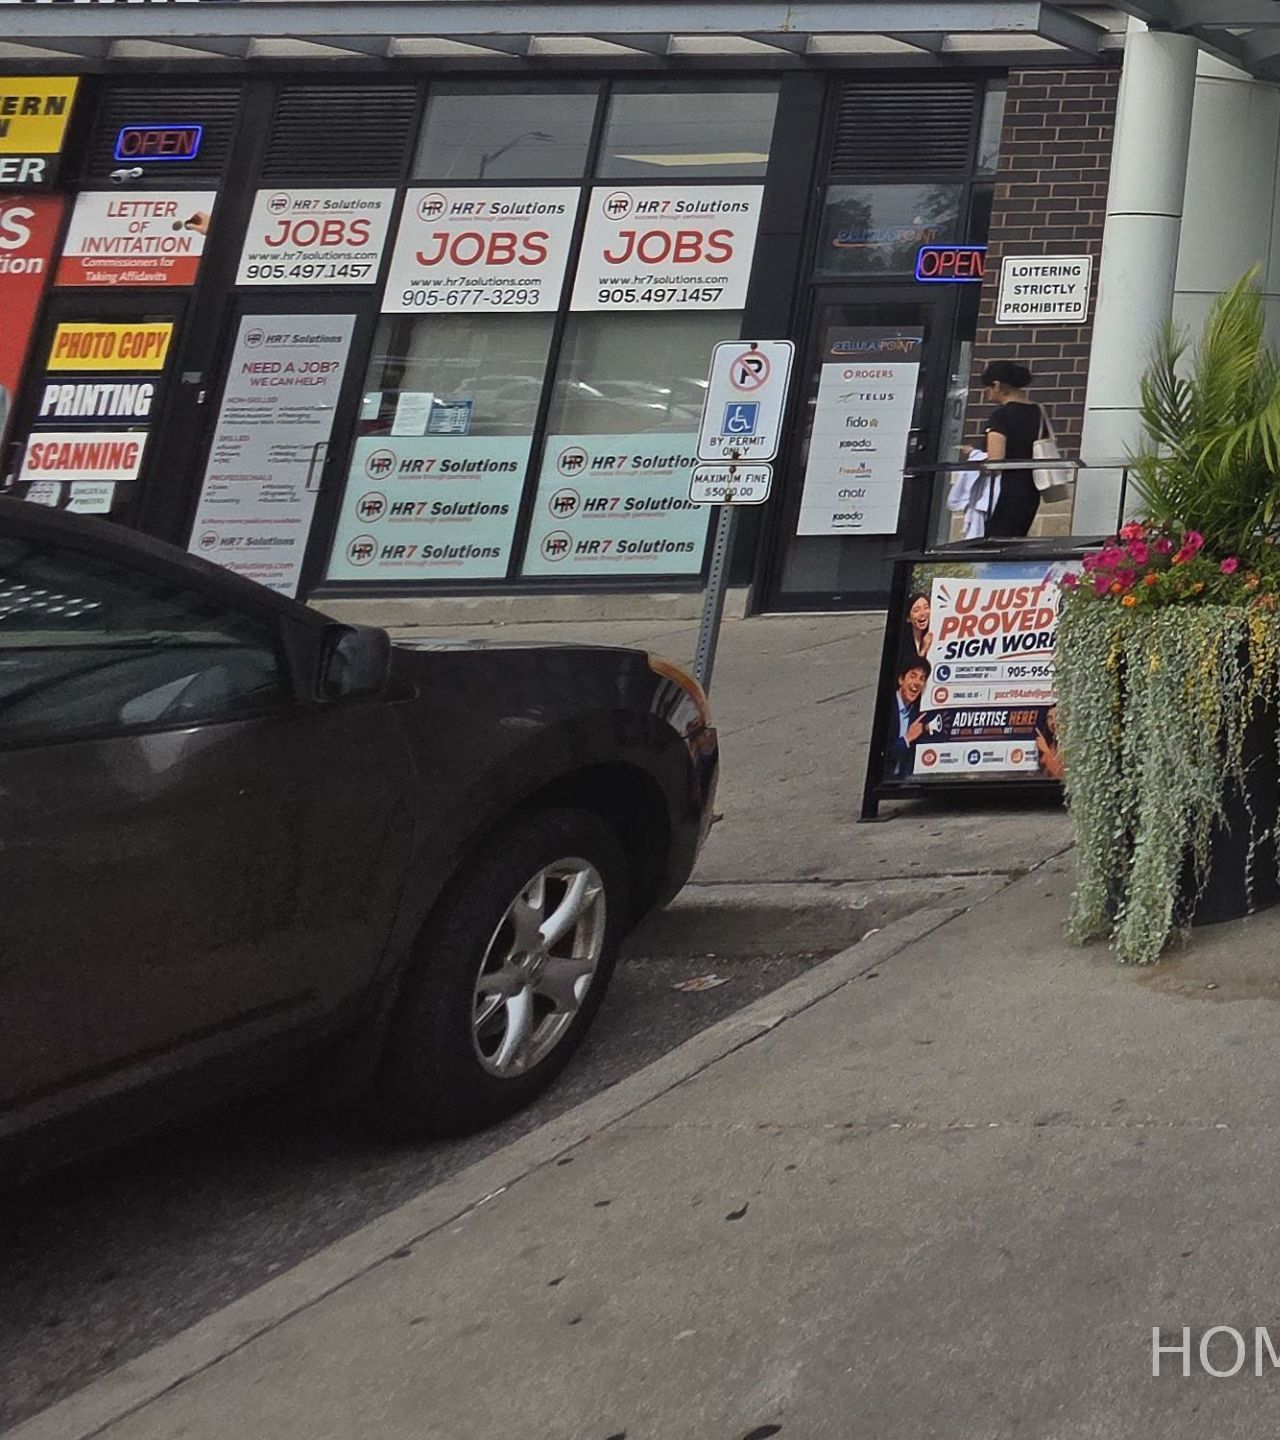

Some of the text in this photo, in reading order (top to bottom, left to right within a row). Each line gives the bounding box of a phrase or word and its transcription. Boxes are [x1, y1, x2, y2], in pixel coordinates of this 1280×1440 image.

[0, 96, 68, 116] ERN
[120, 131, 197, 155] OPEN
[107, 201, 178, 218] LETTER
[293, 198, 382, 210] HR7 Solutions
[451, 201, 566, 215] HR7 Solutions
[637, 199, 749, 213] HR7 Solutions
[0, 207, 36, 250] S
[128, 221, 150, 234] OF
[264, 218, 372, 248] JOBS
[81, 237, 192, 253] INVITATION
[416, 231, 550, 267] JOBS
[603, 229, 735, 265] JOBS
[247, 250, 378, 262] www.hr7solutions.com
[920, 250, 986, 276] OPEN
[246, 263, 373, 280] 905.497.1457
[1012, 266, 1081, 277] LOITERING
[410, 276, 542, 287] www.hr7solutions.com
[599, 275, 728, 285] www.hr7solutions.com
[598, 287, 724, 303] 905.497.1457
[1014, 284, 1076, 295] STRICTLY
[401, 288, 540, 307] 905-677-3293
[1003, 302, 1082, 314] PROHIBITED
[55, 331, 169, 359] PHOTO COPY
[242, 361, 340, 374] NEED A JOB?
[855, 369, 894, 379] ROGERS
[250, 377, 268, 386] WE
[270, 376, 293, 386] CAN
[39, 383, 154, 417] PRINTING
[859, 393, 895, 402] TELUS
[845, 416, 868, 429] fido
[710, 436, 765, 446] BY PERMIT
[27, 441, 139, 470] SCANNING
[721, 446, 750, 456] ONLY
[398, 458, 518, 473] HR7 Solutions
[591, 454, 701, 469] HR7 Solution
[694, 474, 768, 483] MAXIMUM FINE
[704, 487, 753, 497] $5000.00
[837, 488, 867, 498] chatr
[389, 501, 509, 515] HR7 Solutions
[583, 497, 620, 511] HR7
[380, 544, 501, 558] HR7 Solutions
[575, 538, 695, 554] HR7 Solutions
[955, 584, 1047, 615] U JUST
[938, 607, 1055, 641] PROVED
[943, 637, 998, 660] SIGN
[951, 709, 1039, 727] ADVERTISE HERE!
